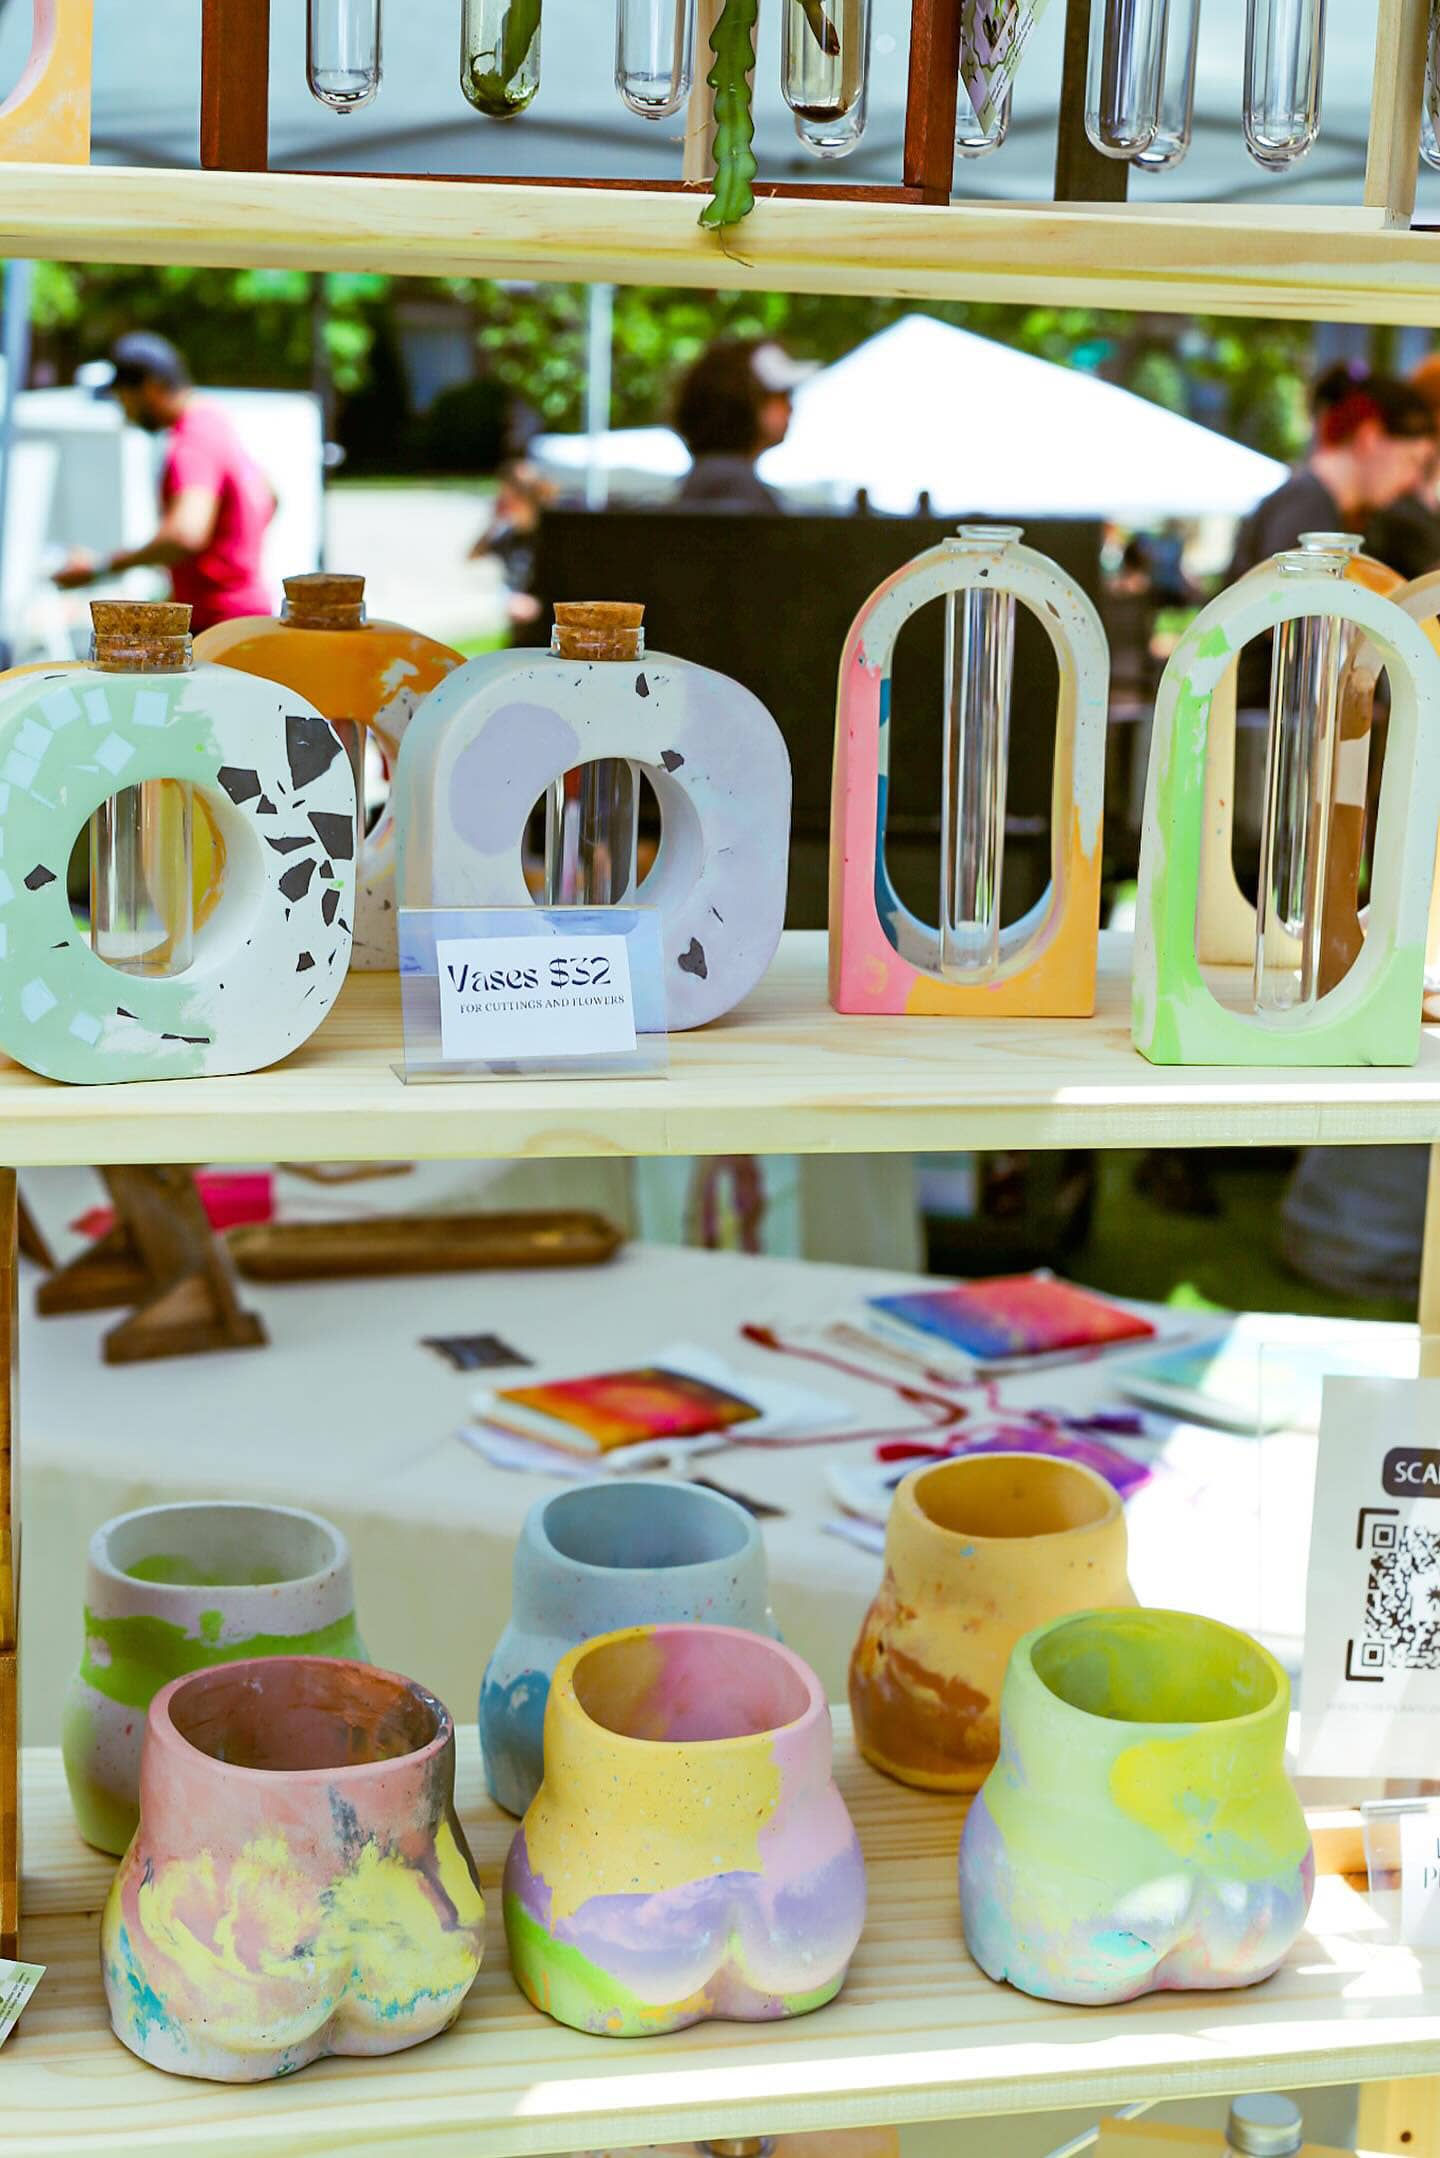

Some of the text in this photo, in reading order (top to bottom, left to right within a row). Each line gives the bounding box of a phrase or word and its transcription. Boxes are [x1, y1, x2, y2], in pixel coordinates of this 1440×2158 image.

[447, 956, 612, 993] Vases $32
[460, 994, 625, 1014] FOR CUTTINGS AND FLOWERS
[1394, 1460, 1440, 1485] SCA
